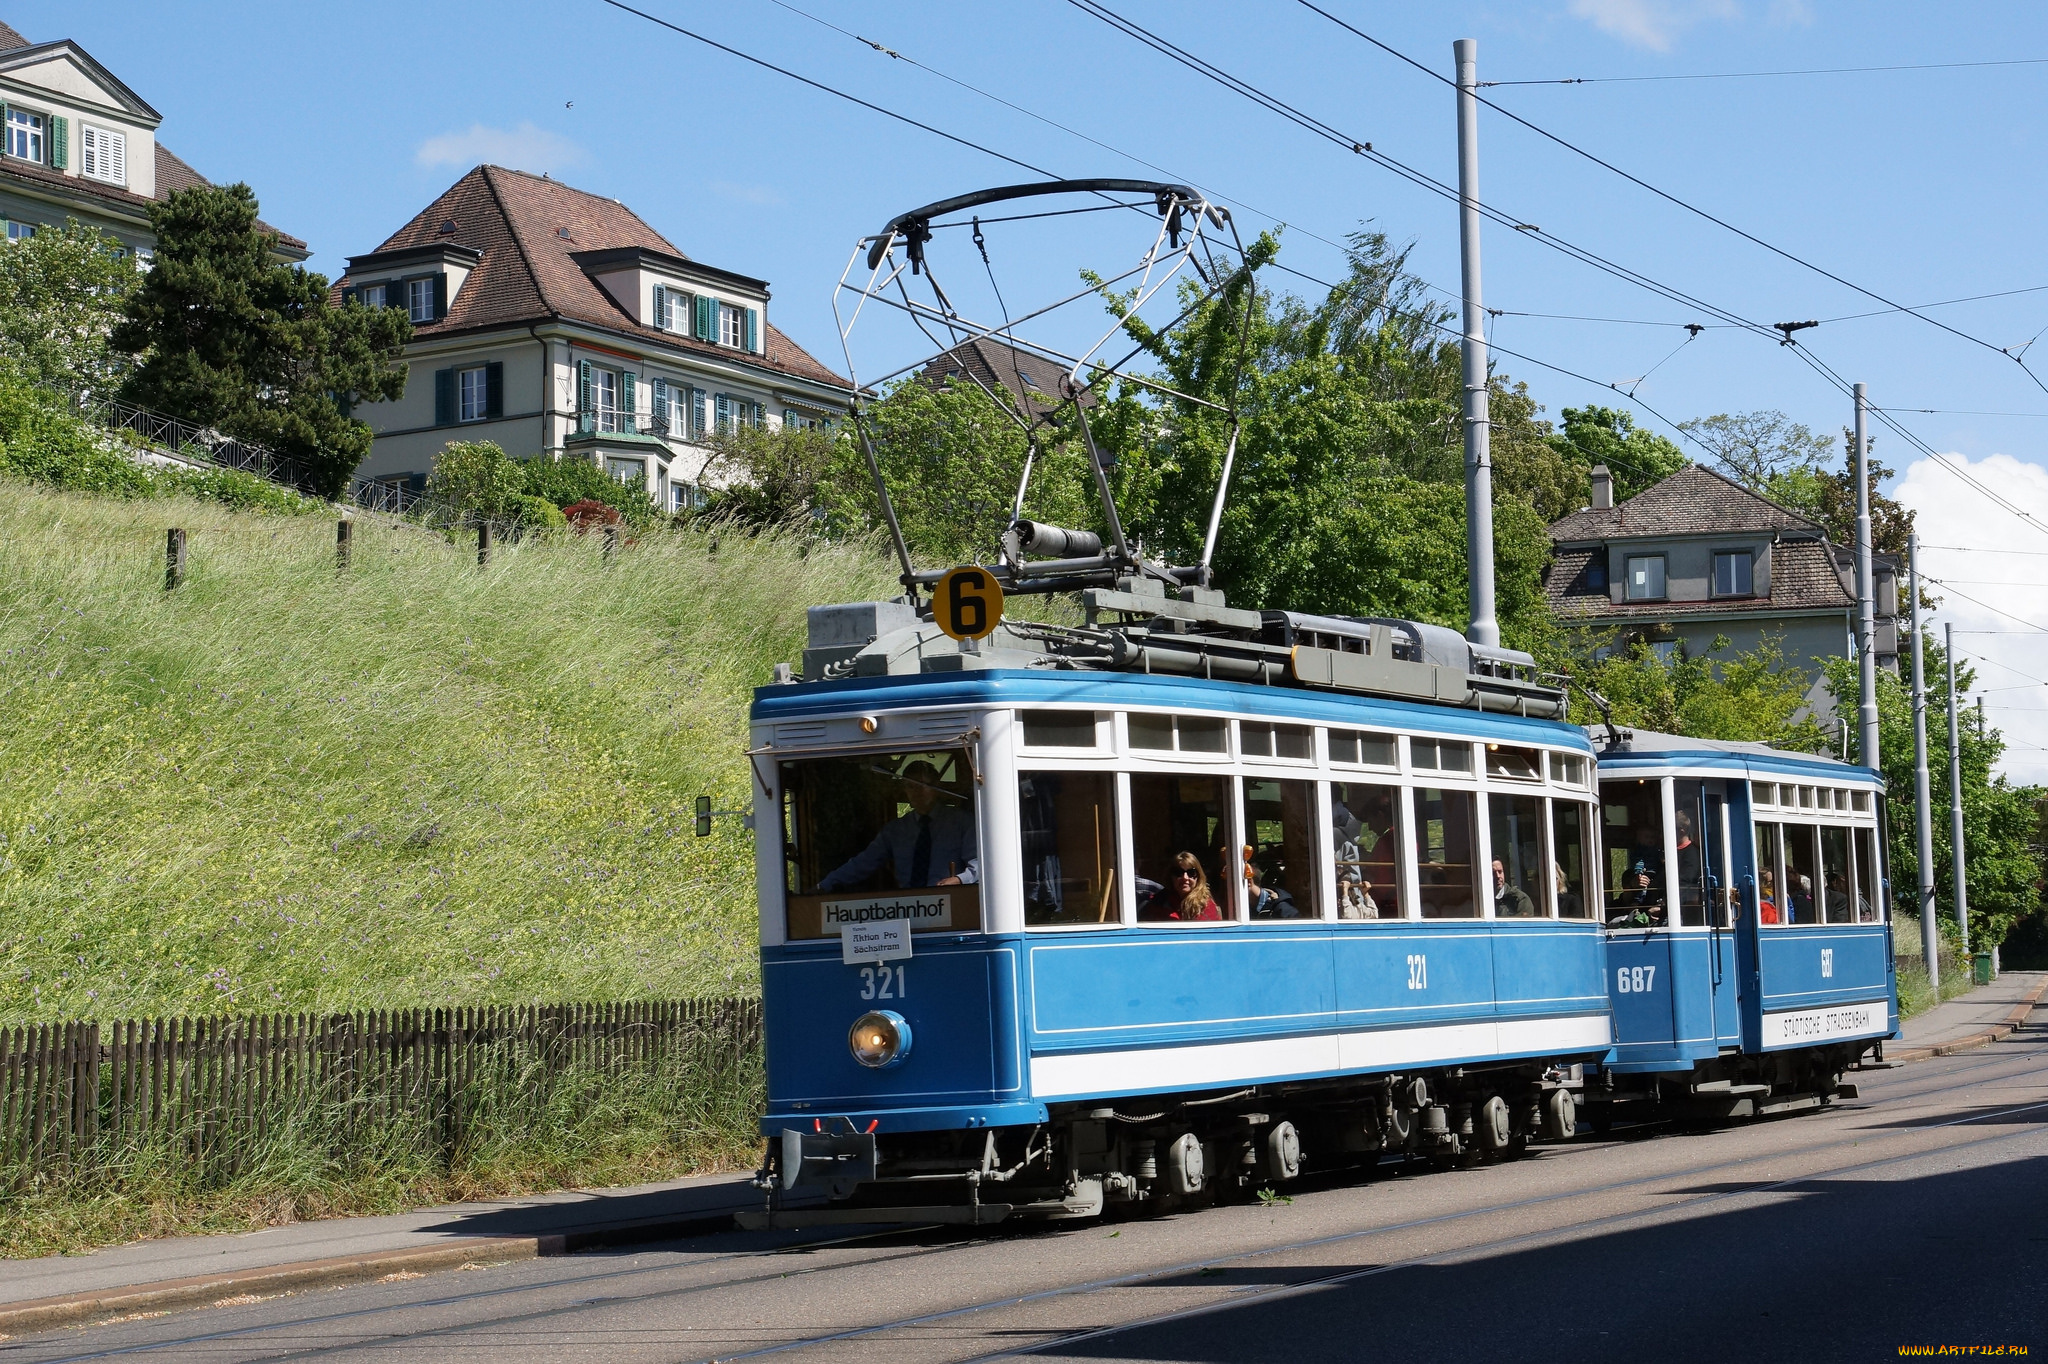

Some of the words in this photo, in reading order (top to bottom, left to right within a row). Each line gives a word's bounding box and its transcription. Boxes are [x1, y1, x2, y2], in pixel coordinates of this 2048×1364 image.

[949, 571, 986, 635] 6
[826, 899, 944, 923] Hauptbahnhof
[852, 932, 880, 943] Aktion
[883, 931, 898, 940] Pro
[1407, 954, 1427, 990] 321
[1821, 948, 1833, 978] 687
[860, 965, 905, 1000] 321
[1617, 965, 1656, 993] 687
[1783, 1014, 1820, 1038] STÄDTISCHE
[1826, 1009, 1870, 1033] STRASSENBAHN
